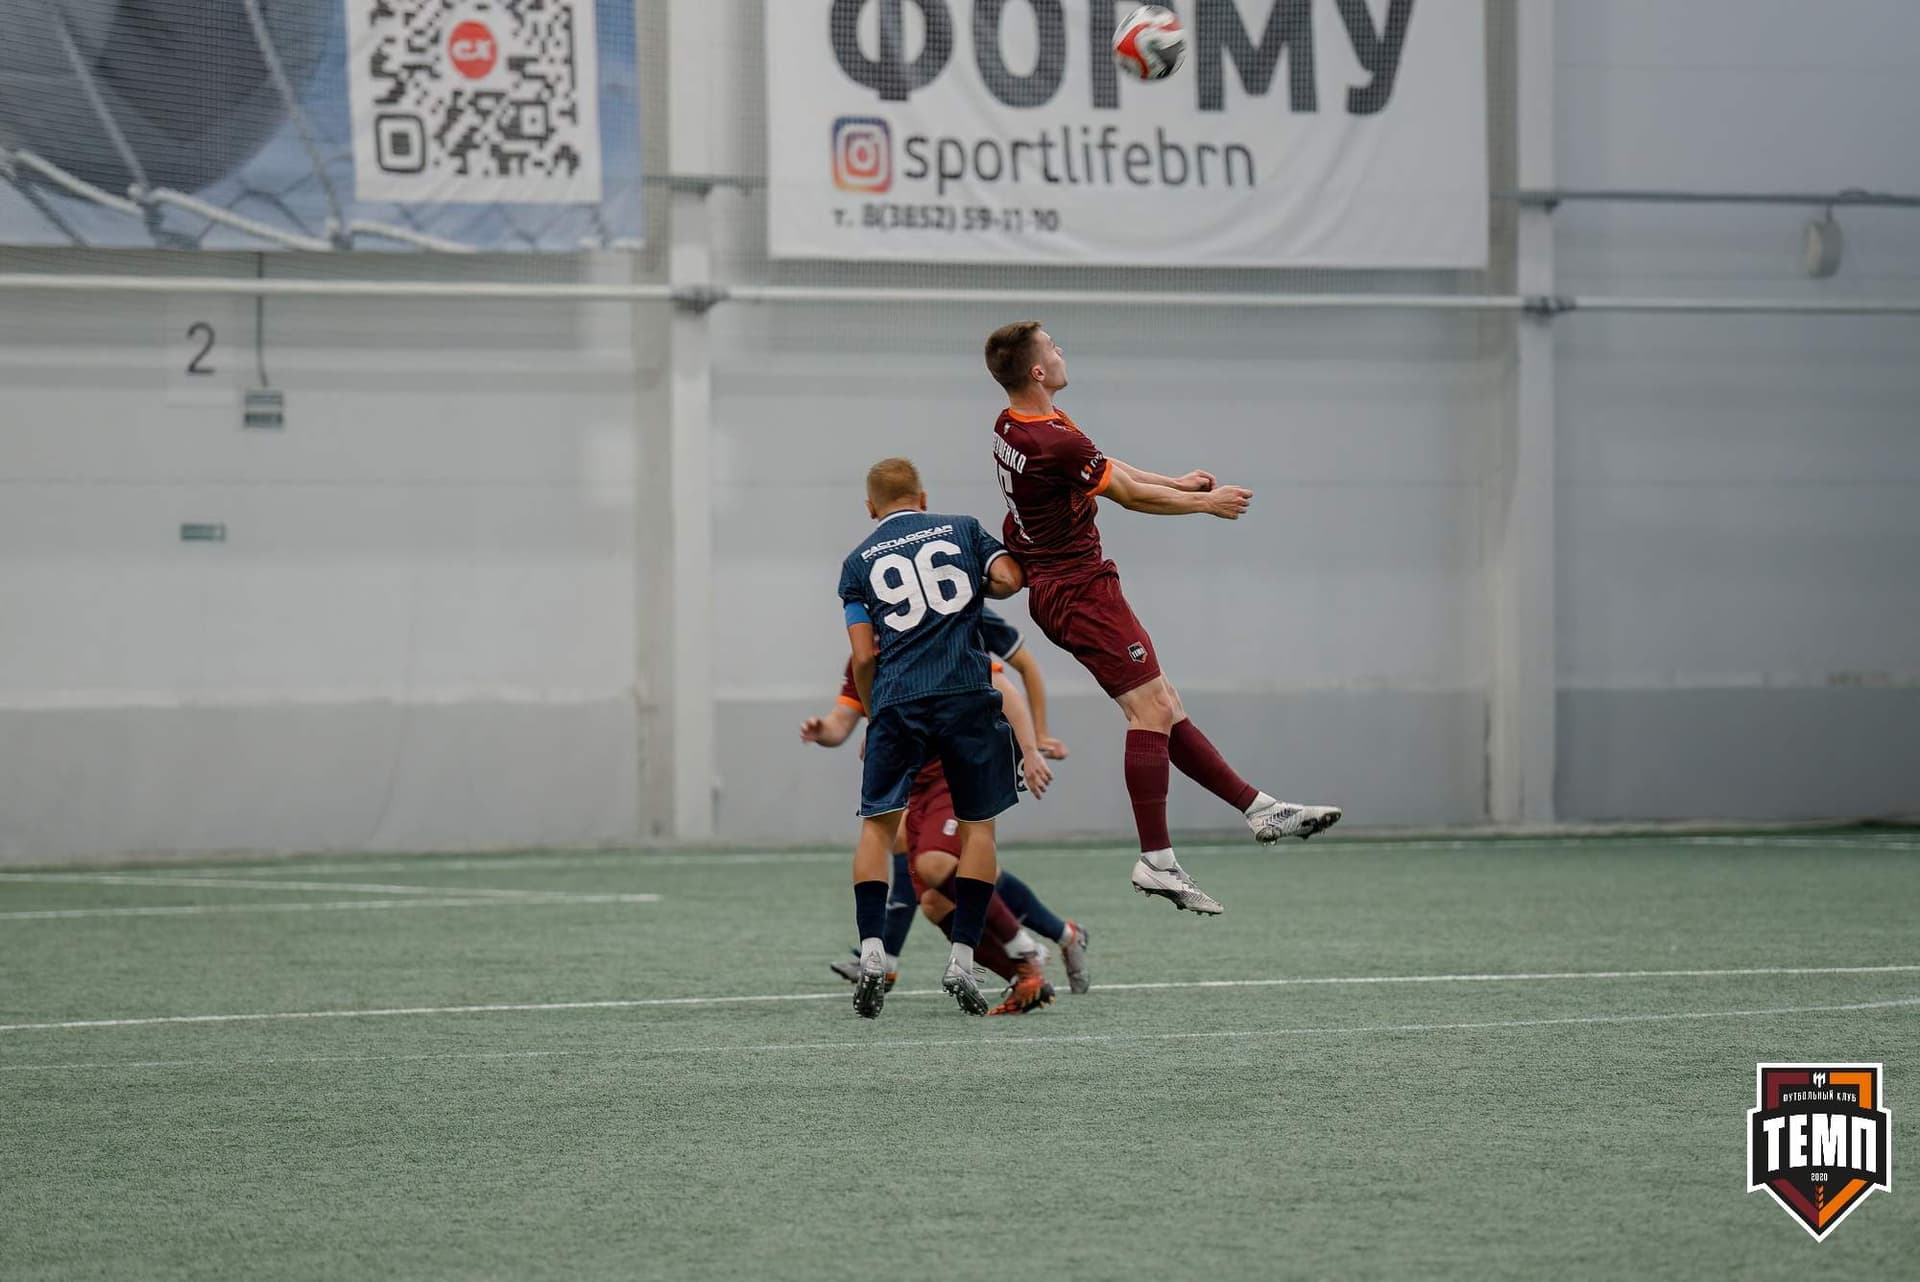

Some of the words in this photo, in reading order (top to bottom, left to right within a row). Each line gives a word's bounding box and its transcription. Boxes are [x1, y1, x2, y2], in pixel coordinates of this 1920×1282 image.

[903, 124, 1256, 196] sportlifebrn
[186, 321, 216, 376] 2
[869, 540, 974, 632] 96
